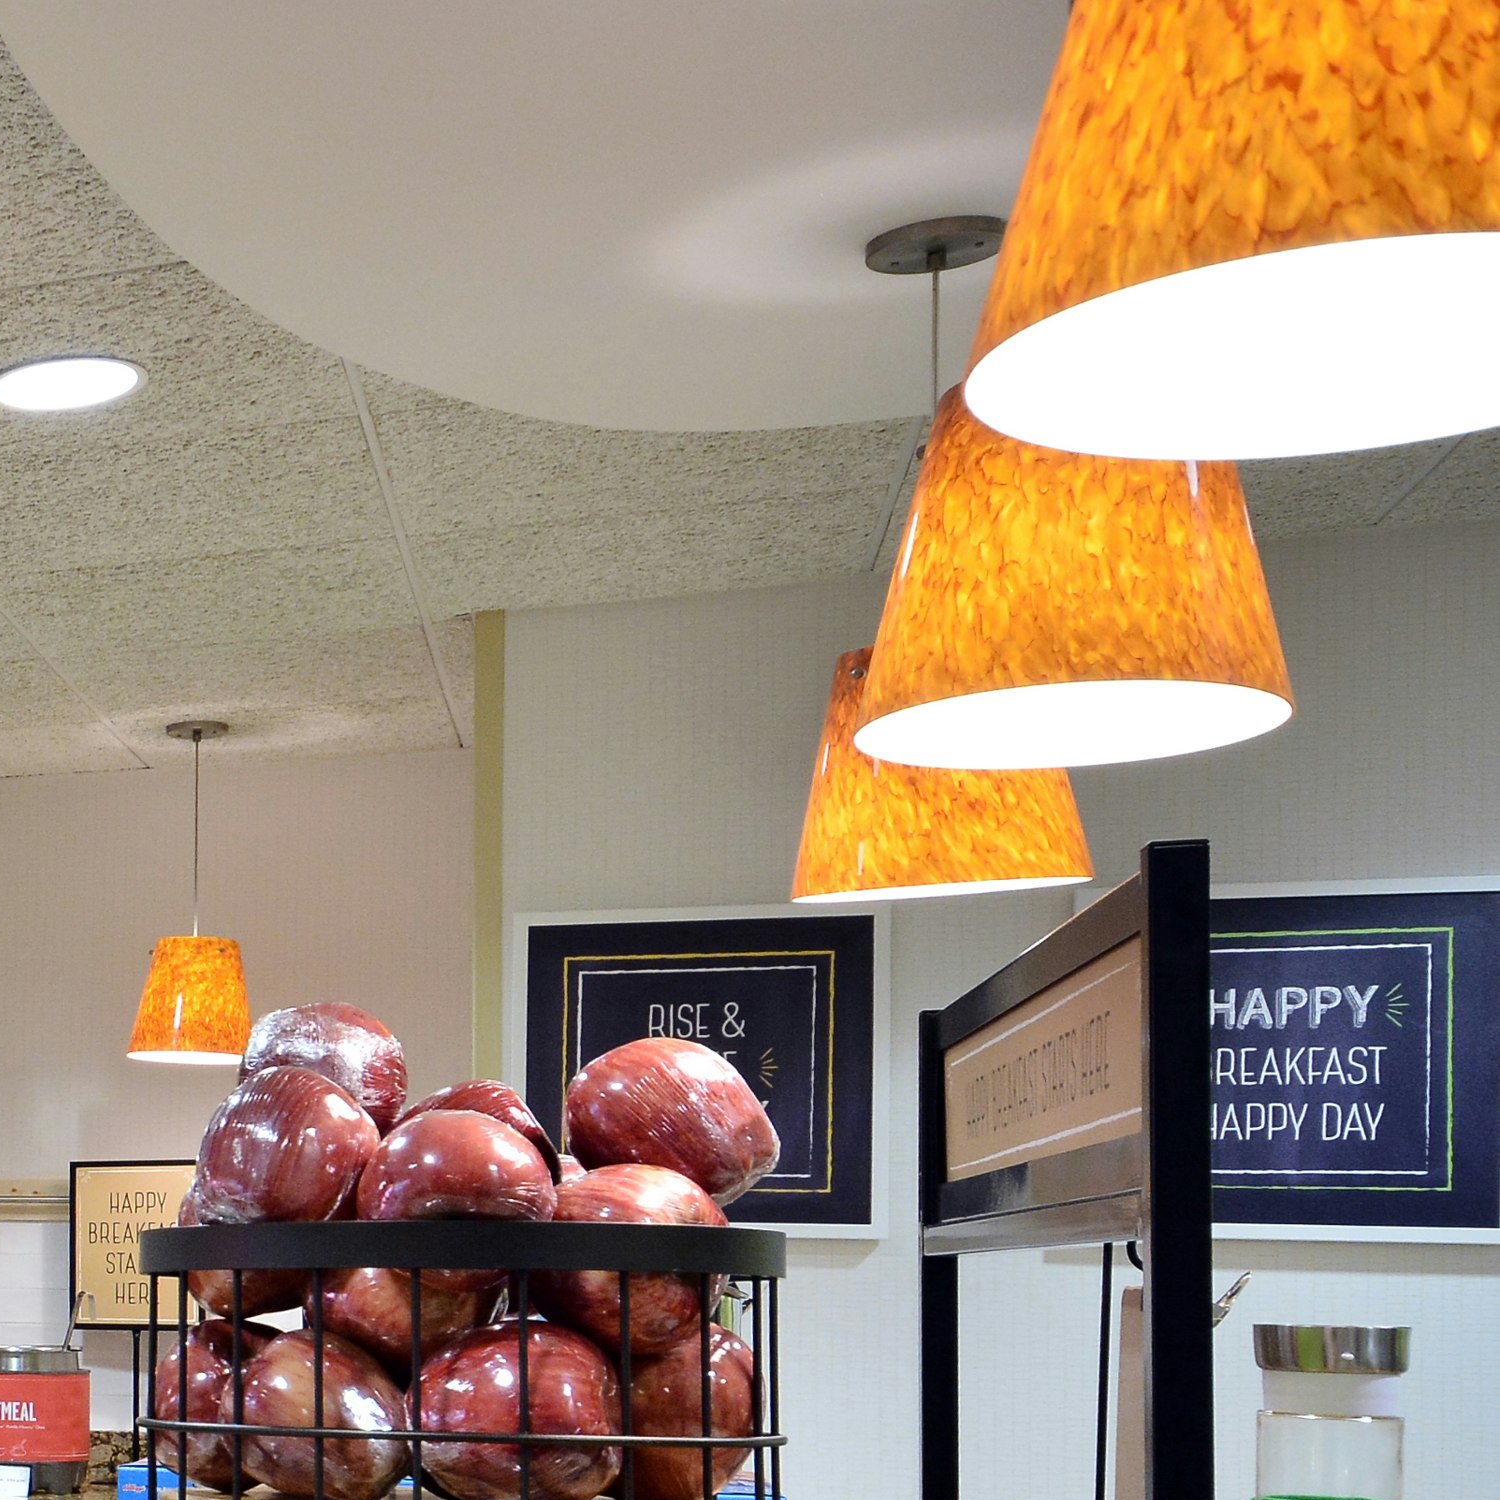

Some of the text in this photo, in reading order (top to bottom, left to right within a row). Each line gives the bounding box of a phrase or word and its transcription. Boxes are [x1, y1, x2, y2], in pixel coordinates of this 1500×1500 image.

[648, 1002, 746, 1039] RISE &
[1210, 984, 1380, 1030] HAPPY
[1211, 1046, 1388, 1085] REAKFAST
[1321, 1102, 1385, 1141] DAY
[109, 1192, 167, 1214] HAPPY
[88, 1222, 178, 1244] BREAK
[106, 1252, 137, 1275] STA
[115, 1282, 159, 1304] HER
